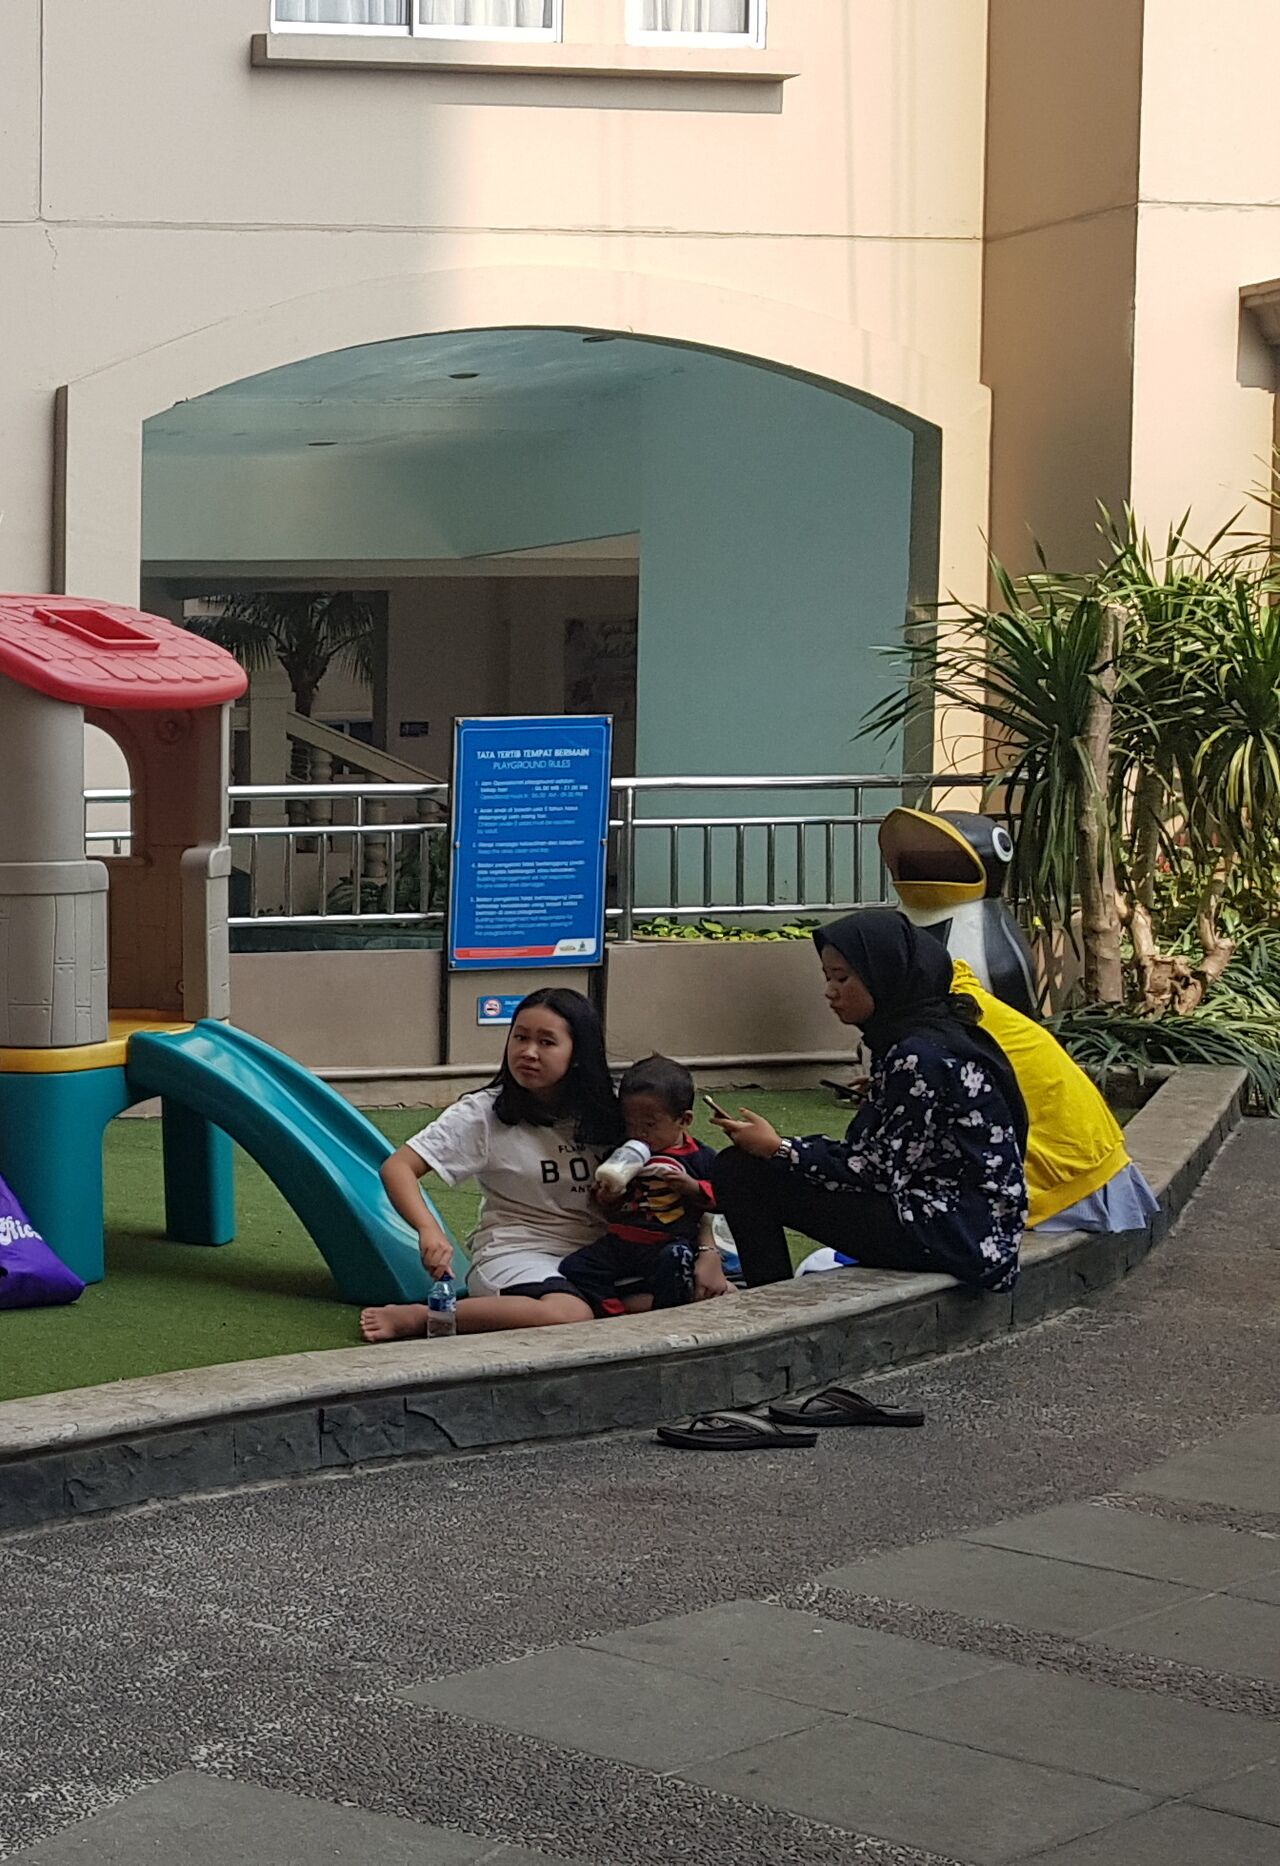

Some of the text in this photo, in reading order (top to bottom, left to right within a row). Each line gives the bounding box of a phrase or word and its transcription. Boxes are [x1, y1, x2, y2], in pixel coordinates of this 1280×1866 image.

[477, 751, 496, 759] TATA
[523, 749, 553, 758] TEMPAT
[554, 748, 590, 757] BERMAIN
[492, 759, 571, 770] PLAYGROUND RULES
